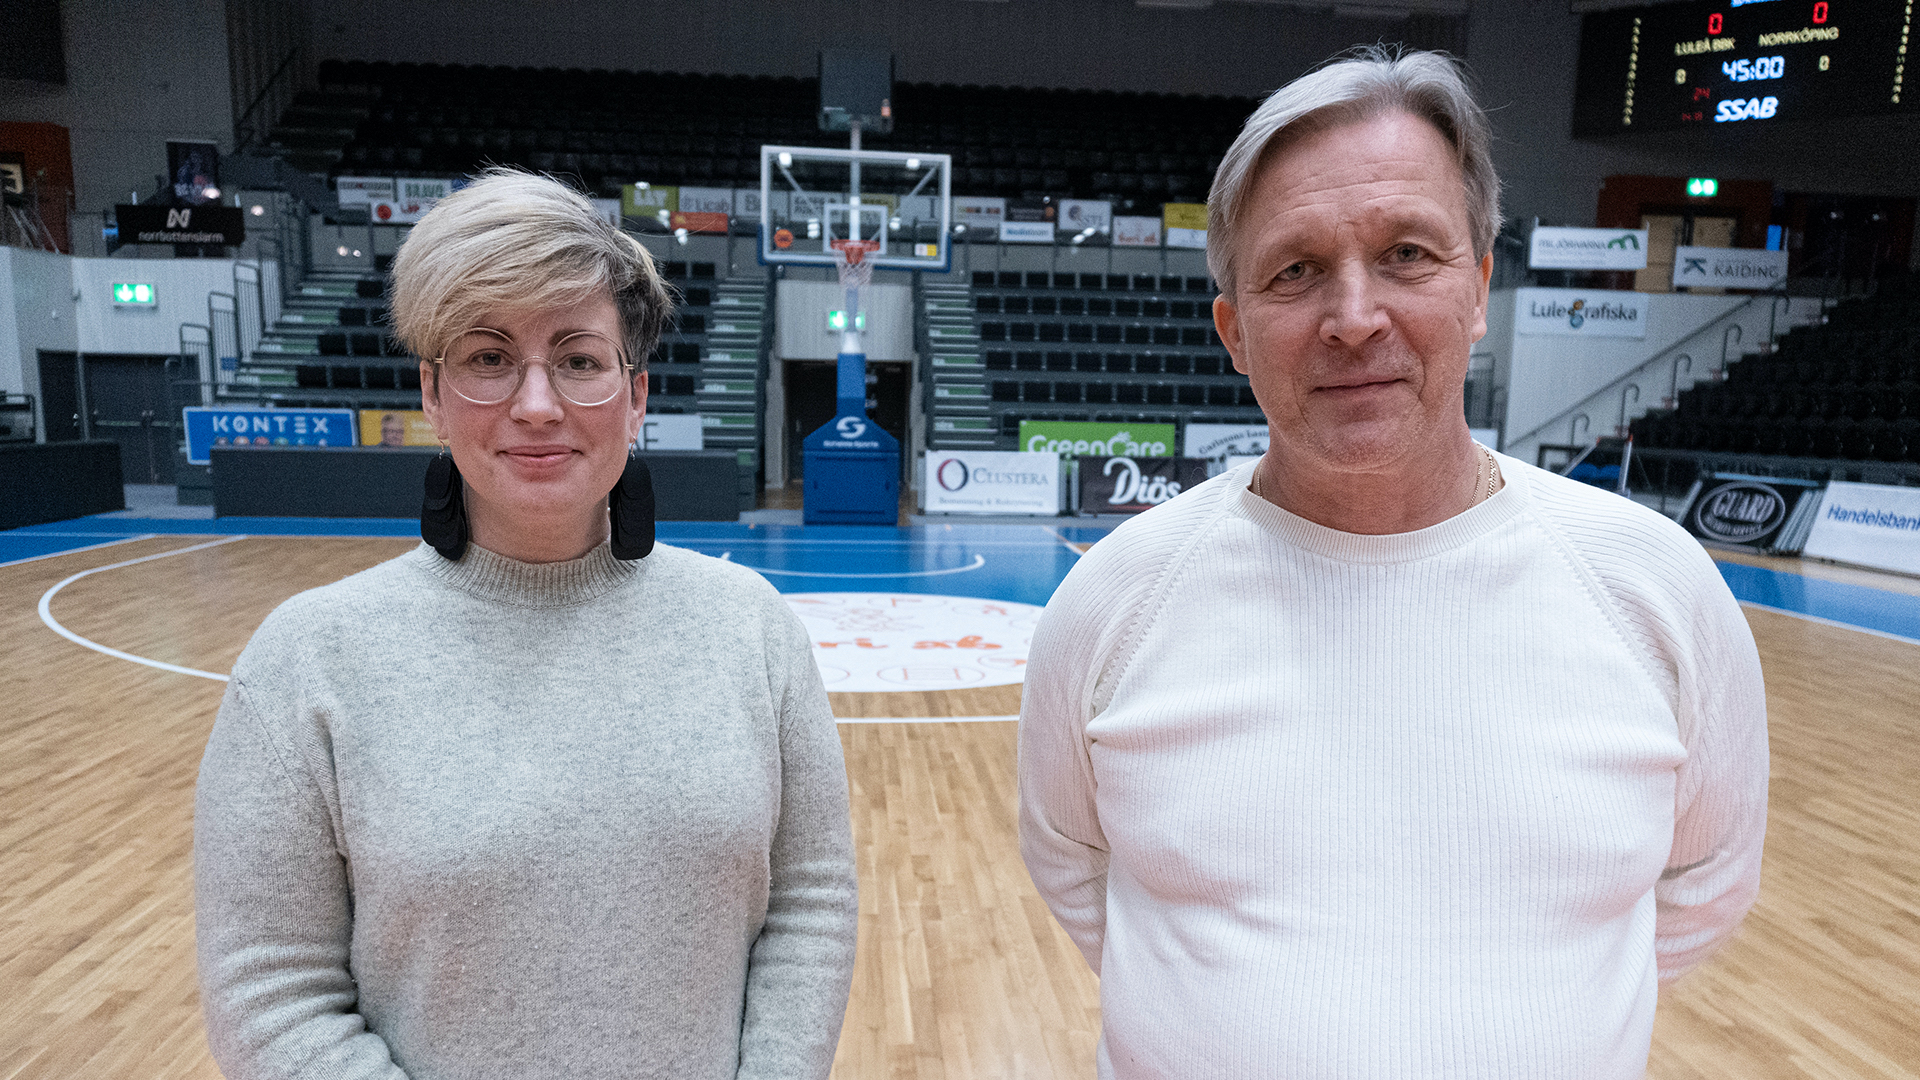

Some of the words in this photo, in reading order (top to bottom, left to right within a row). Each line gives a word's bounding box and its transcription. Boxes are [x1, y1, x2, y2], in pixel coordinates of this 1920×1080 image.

[1813, 2, 1828, 23] 0
[1708, 13, 1722, 34] 0
[1674, 38, 1711, 56] LULEÅ
[1758, 27, 1839, 47] NORRKÖPING
[1722, 56, 1785, 82] 45:00
[1714, 96, 1779, 122] SSAB
[1713, 264, 1779, 279] KAIDING
[212, 415, 329, 434] KONTEX
[1103, 456, 1182, 505] Diös
[1713, 490, 1776, 523] GUARD
